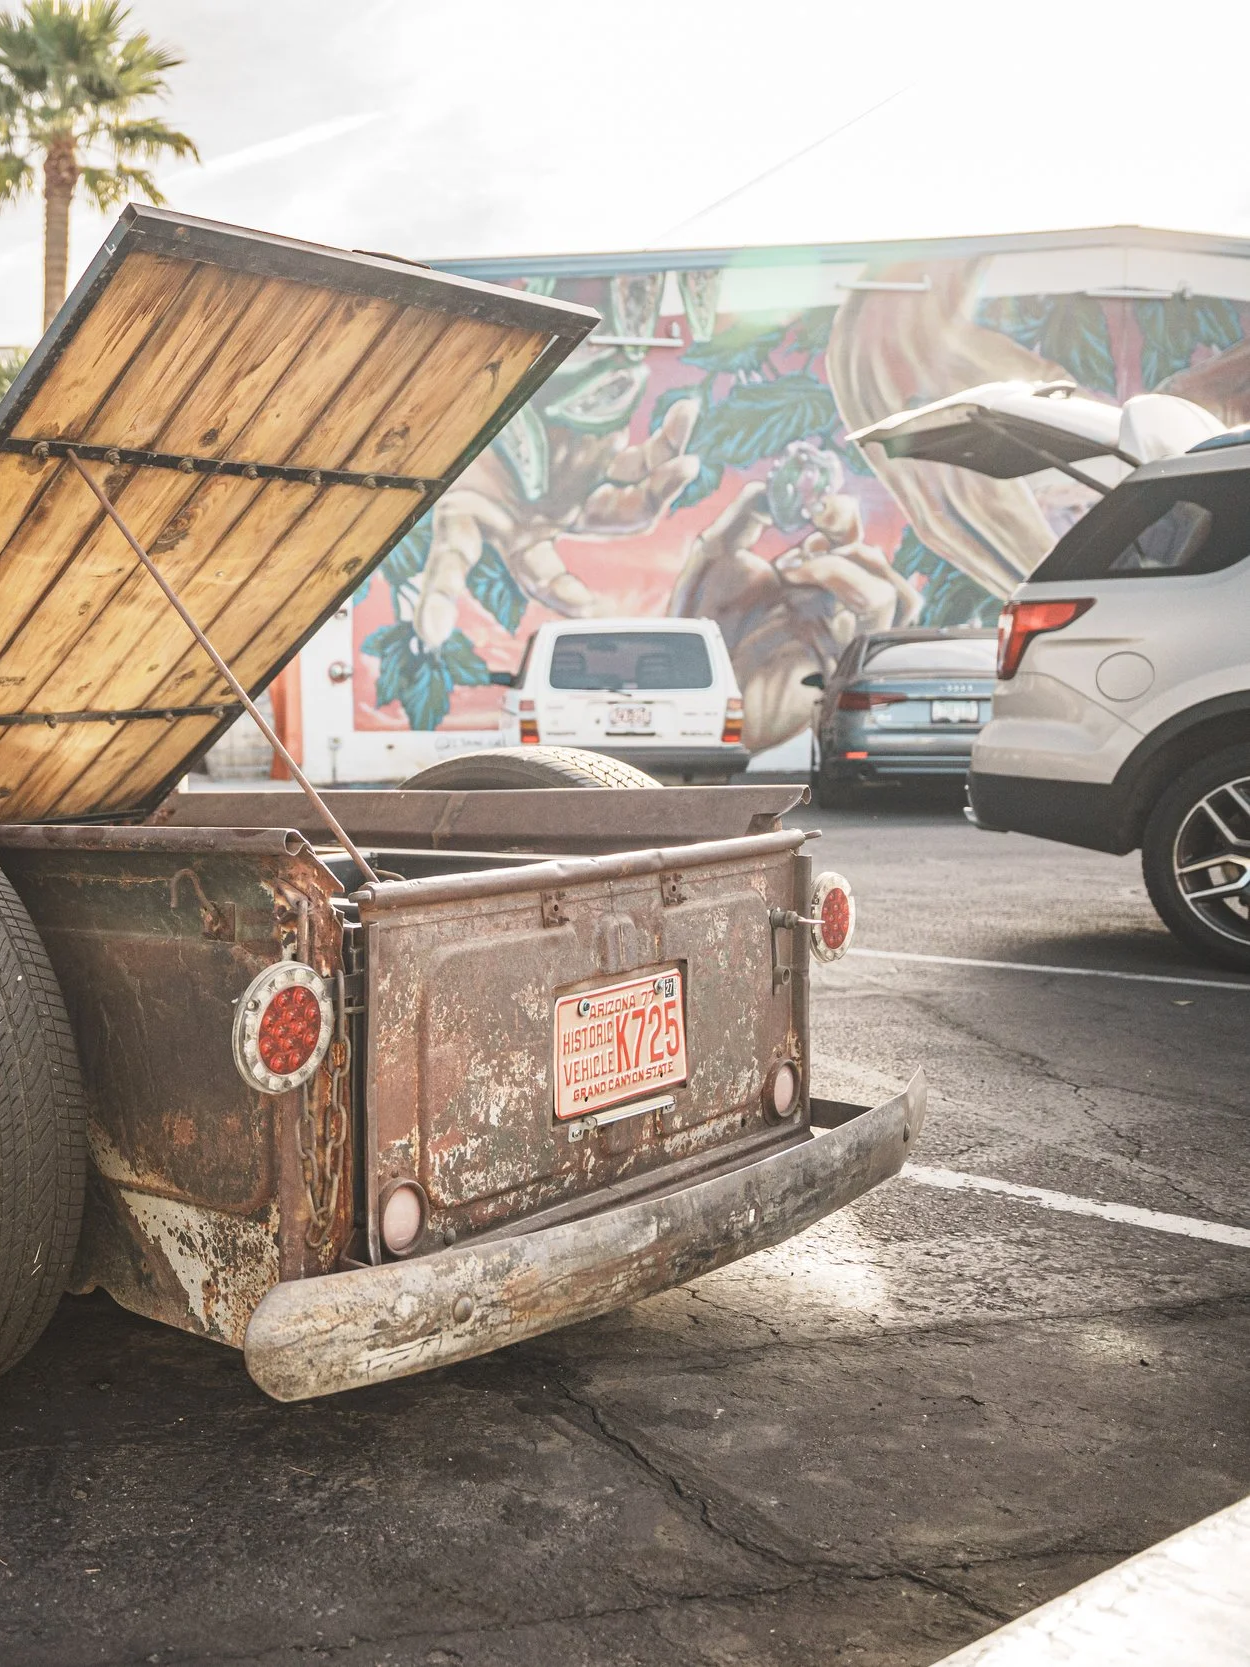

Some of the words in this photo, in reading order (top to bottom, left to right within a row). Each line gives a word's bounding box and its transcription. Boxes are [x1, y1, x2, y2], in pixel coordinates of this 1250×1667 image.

[666, 982, 673, 994] 27
[588, 993, 636, 1020] ARIZONA
[562, 1020, 613, 1056] HISTORIC
[615, 1000, 680, 1074] K725
[563, 1051, 615, 1087] VEHICLE
[573, 1081, 607, 1102] GRAND
[608, 1070, 644, 1090] CANYON
[645, 1061, 674, 1080] STATE
